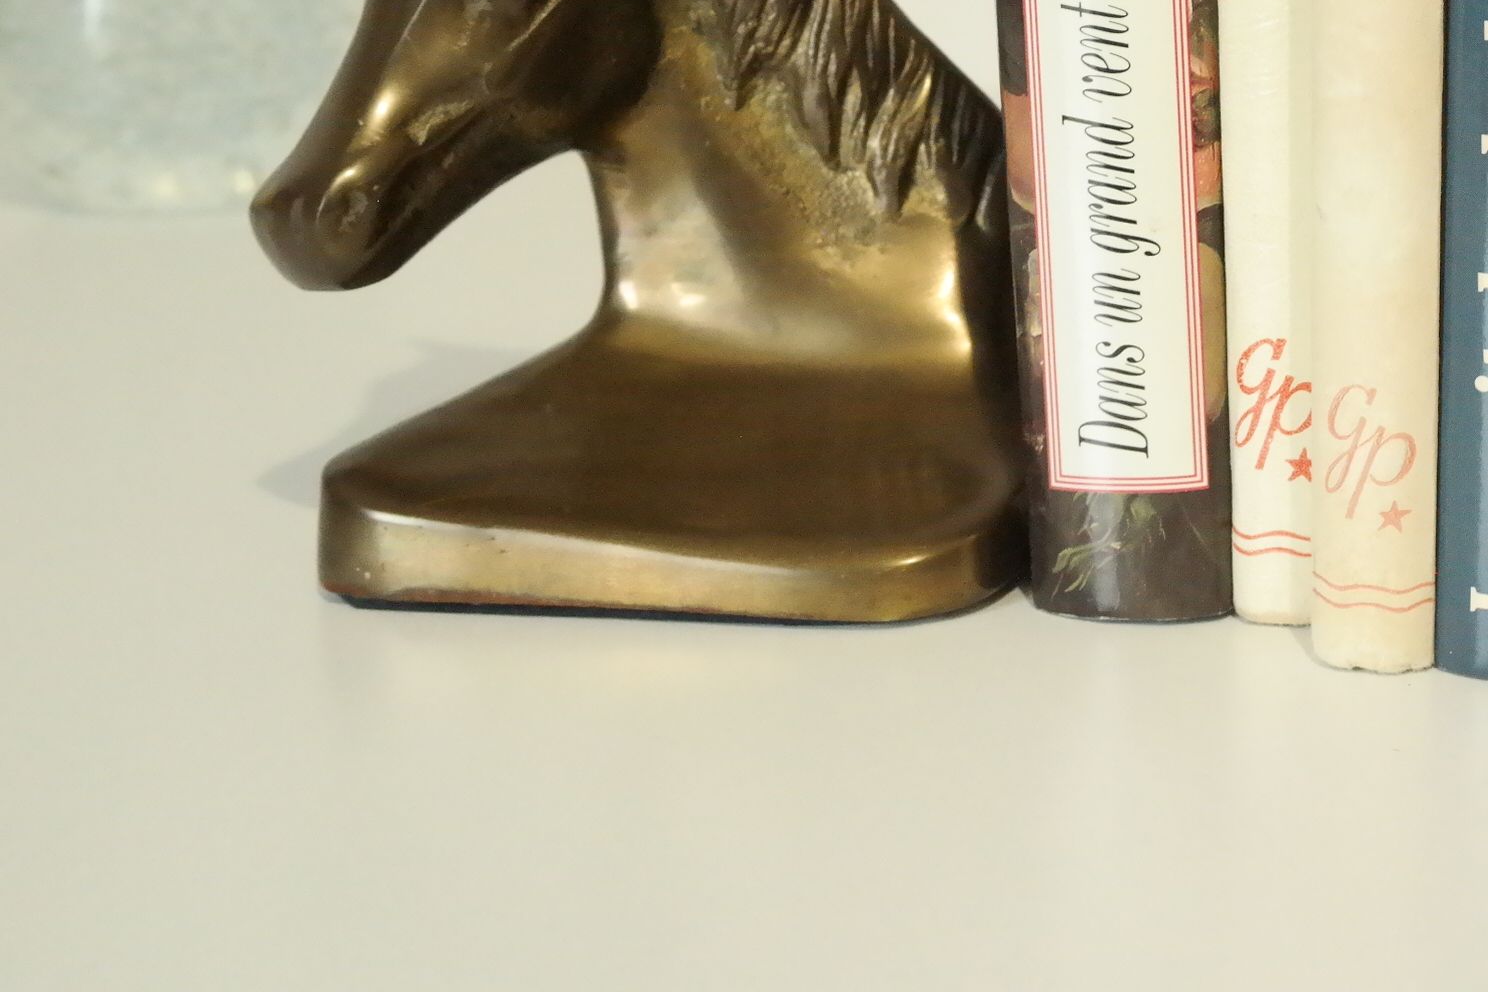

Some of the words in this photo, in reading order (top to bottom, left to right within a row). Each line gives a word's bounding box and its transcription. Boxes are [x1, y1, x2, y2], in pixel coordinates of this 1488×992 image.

[1060, 5, 1132, 102] vent
[1062, 115, 1161, 256] grand
[1092, 268, 1143, 327] un
[1078, 341, 1149, 458] Dans
